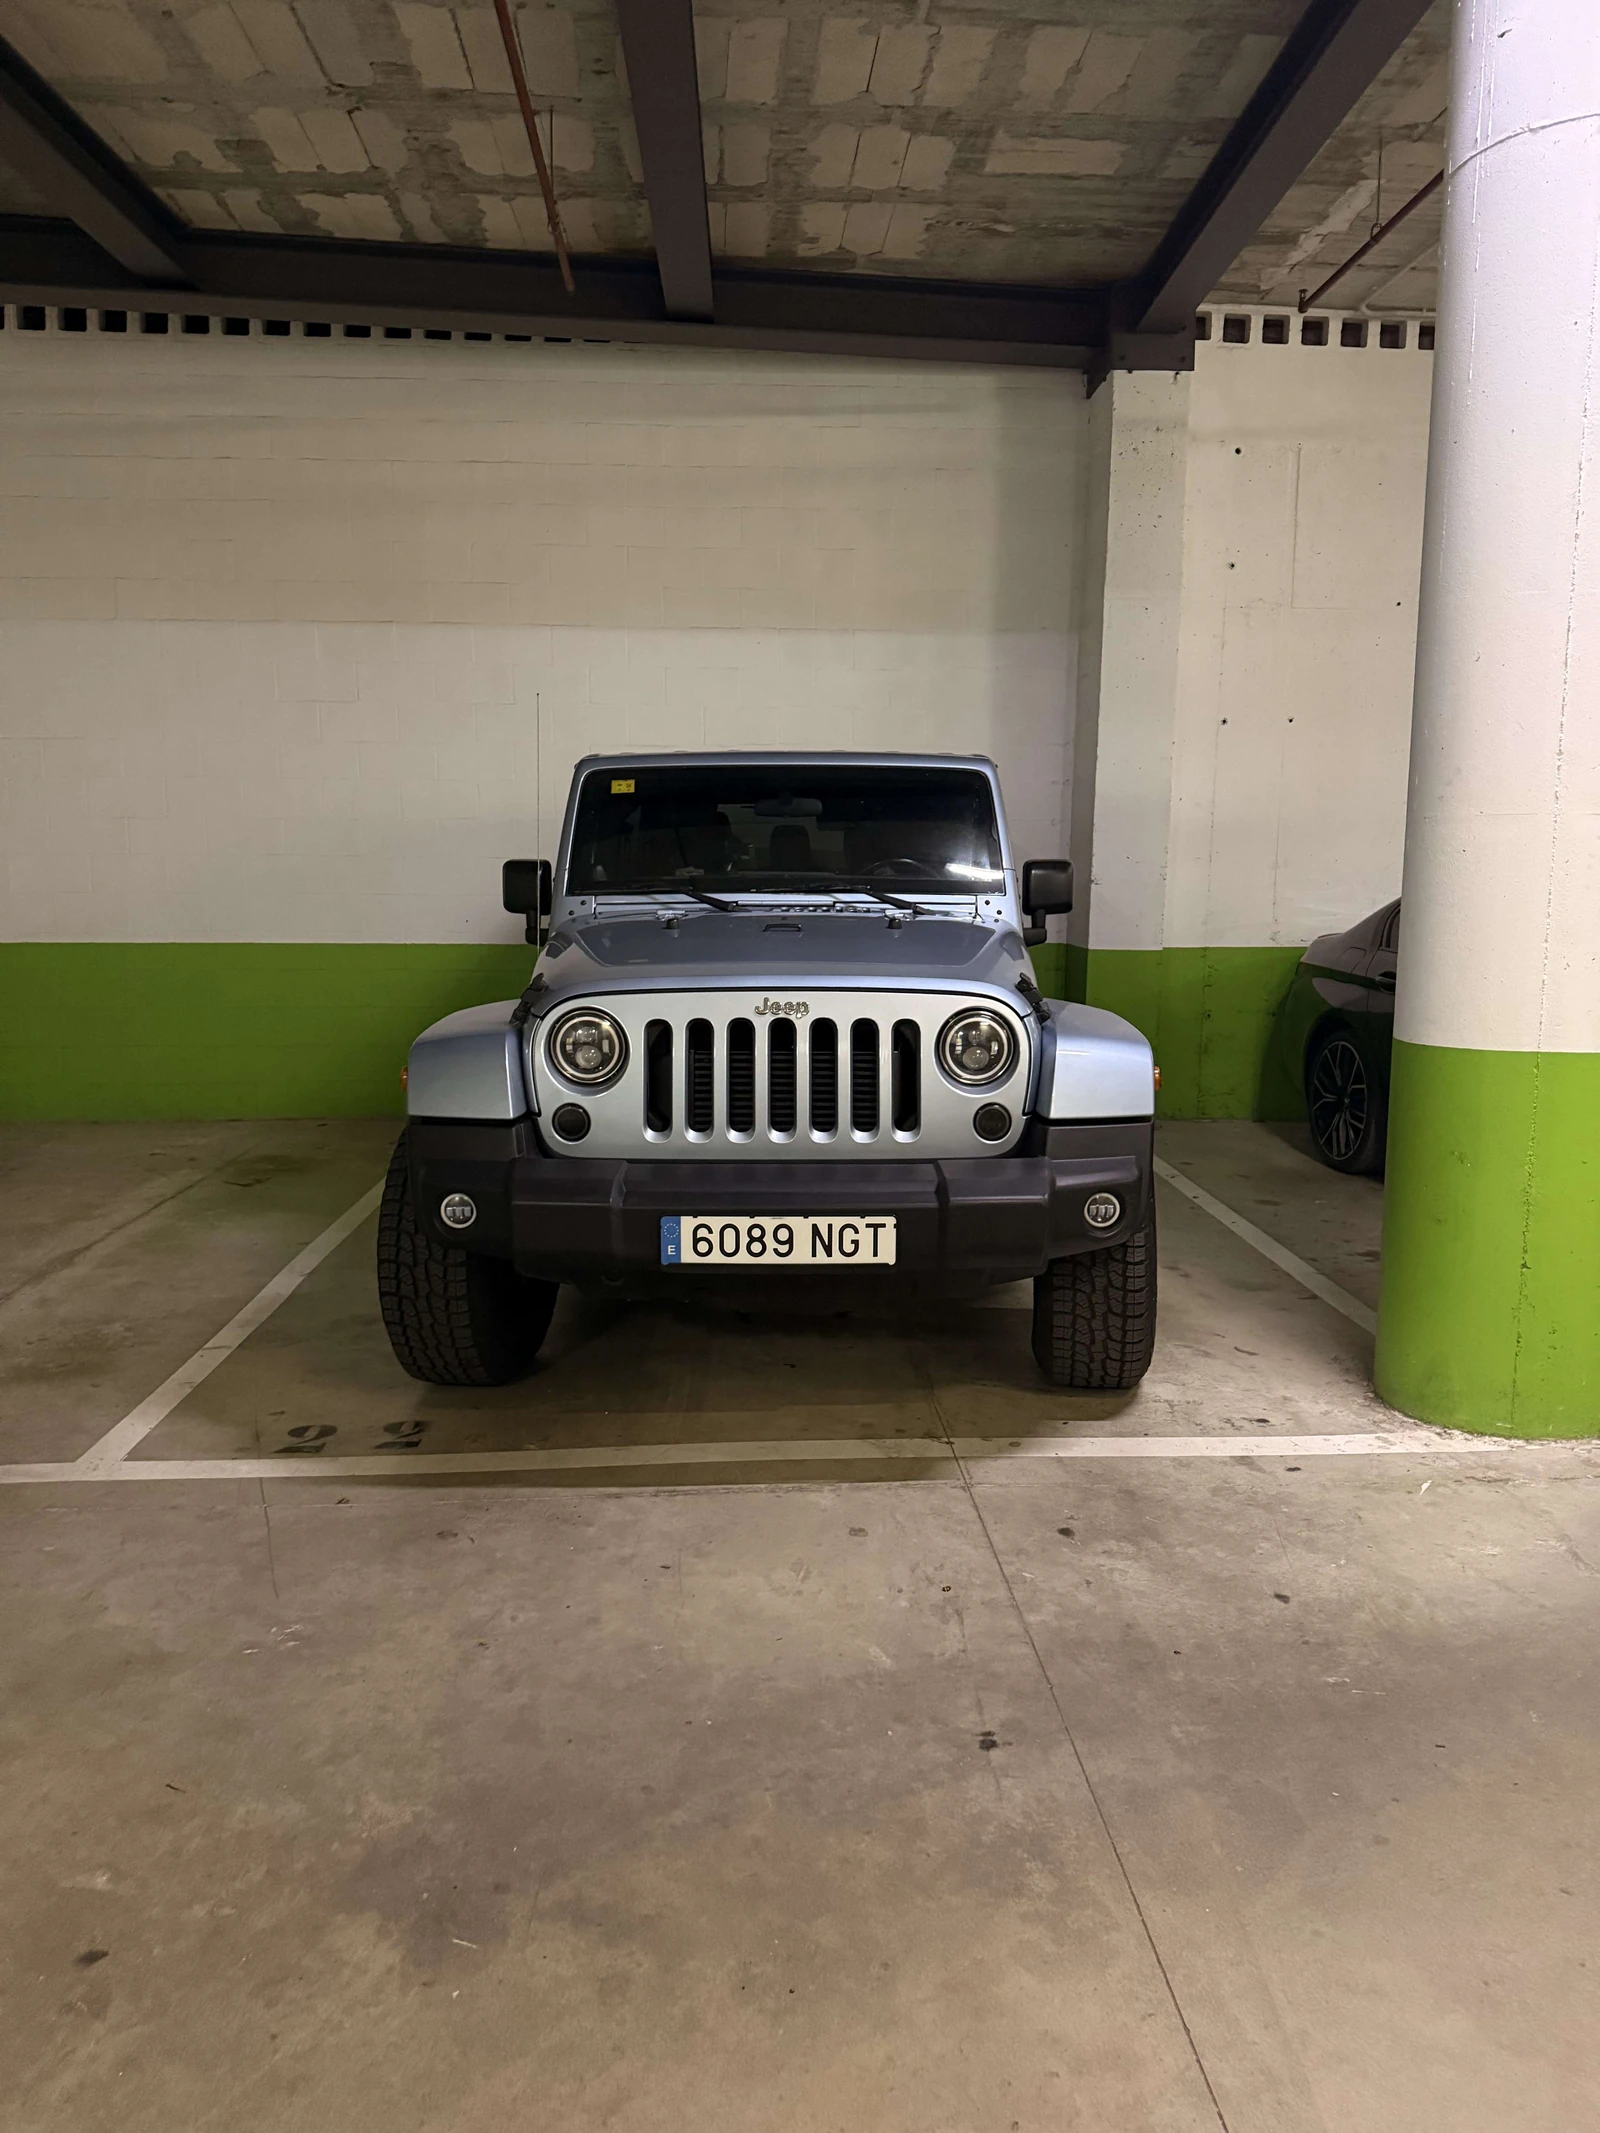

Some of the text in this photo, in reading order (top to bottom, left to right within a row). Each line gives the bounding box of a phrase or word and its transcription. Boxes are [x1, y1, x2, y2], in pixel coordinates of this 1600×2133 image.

[754, 996, 810, 1019] Jeep
[667, 1245, 676, 1255] E
[692, 1223, 887, 1258] 6089 NGT
